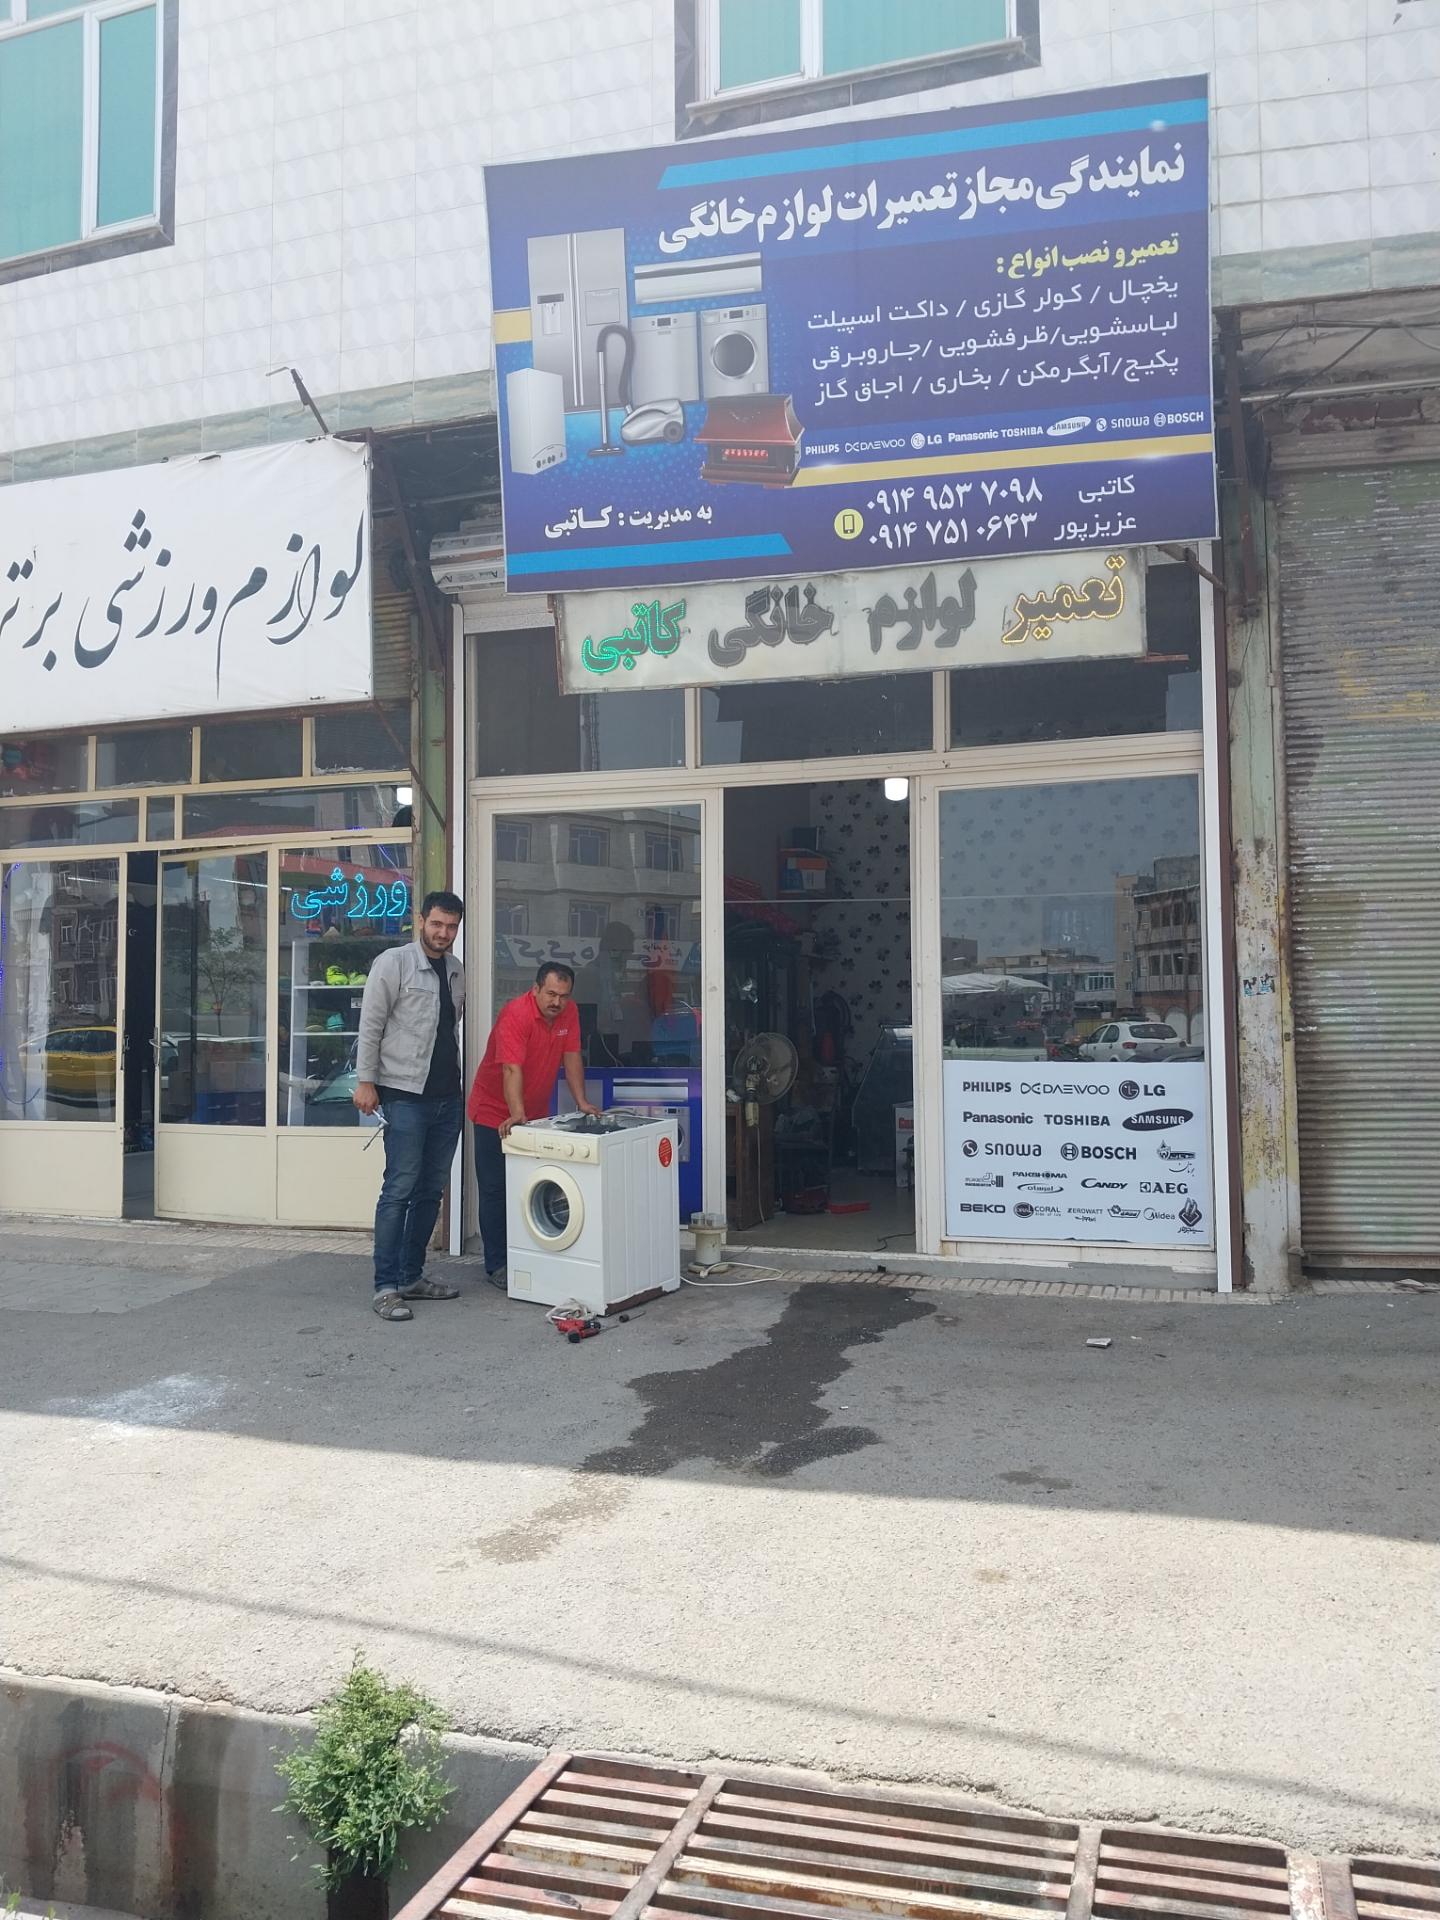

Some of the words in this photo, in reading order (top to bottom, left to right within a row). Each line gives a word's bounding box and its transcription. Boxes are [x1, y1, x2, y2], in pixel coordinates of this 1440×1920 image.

[1036, 142, 1185, 210] نمایندگی
[837, 172, 958, 229] تعمیرات
[958, 166, 1034, 220] مجاز
[658, 196, 755, 254] خانگی
[757, 184, 833, 243] لوازم
[1061, 239, 1110, 272] نصب
[973, 287, 1026, 318] گازی
[1033, 284, 1082, 312] کولر
[1109, 275, 1178, 304] یخچال
[807, 306, 881, 334] اسپیلت
[888, 300, 949, 321] داکت
[814, 377, 848, 406] گاز
[855, 375, 903, 402] اجاق
[930, 368, 992, 395] بخاری
[805, 443, 840, 456] PHILIPS
[860, 438, 906, 450] DAEWOO
[928, 434, 943, 445] LG
[948, 428, 999, 443] Panasonic
[1000, 426, 1044, 438] TOSHIBA
[1167, 411, 1204, 425] BOSCH
[867, 486, 915, 515] ۰۹۱۴
[923, 482, 972, 511] ۹۵۳
[981, 476, 1043, 506] ۷۰۹۸
[1078, 474, 1136, 504] کاتبی
[544, 505, 613, 539] کاتبی
[696, 504, 713, 525] به
[976, 511, 1038, 542] ۰۶۴۳
[1054, 511, 1137, 541] عزیزپور
[869, 521, 918, 550] ۰۹۱۴
[925, 517, 968, 545] ۷۵۱
[74, 508, 218, 669] ورزشی
[1001, 554, 1126, 643] تعمیر
[213, 509, 365, 701] لوازم
[868, 567, 978, 655] لوازم
[581, 598, 687, 675] کاتبی
[707, 582, 835, 668] خانگی
[291, 866, 408, 919] ورزشی
[962, 1081, 1012, 1093] PHILIPS
[1043, 1084, 1110, 1095] DAEWOO
[1143, 1084, 1166, 1096] LG
[963, 1111, 1034, 1124] Panasonic
[1043, 1114, 1111, 1126] TOSHIBA
[1131, 1114, 1185, 1125] SAMSUNG
[1081, 1145, 1137, 1160] BOSCH
[1152, 1182, 1188, 1194] AEG
[960, 1203, 1006, 1214] BEKO
[1034, 1205, 1061, 1213] CORAL
[1147, 1211, 1176, 1220] Midea
